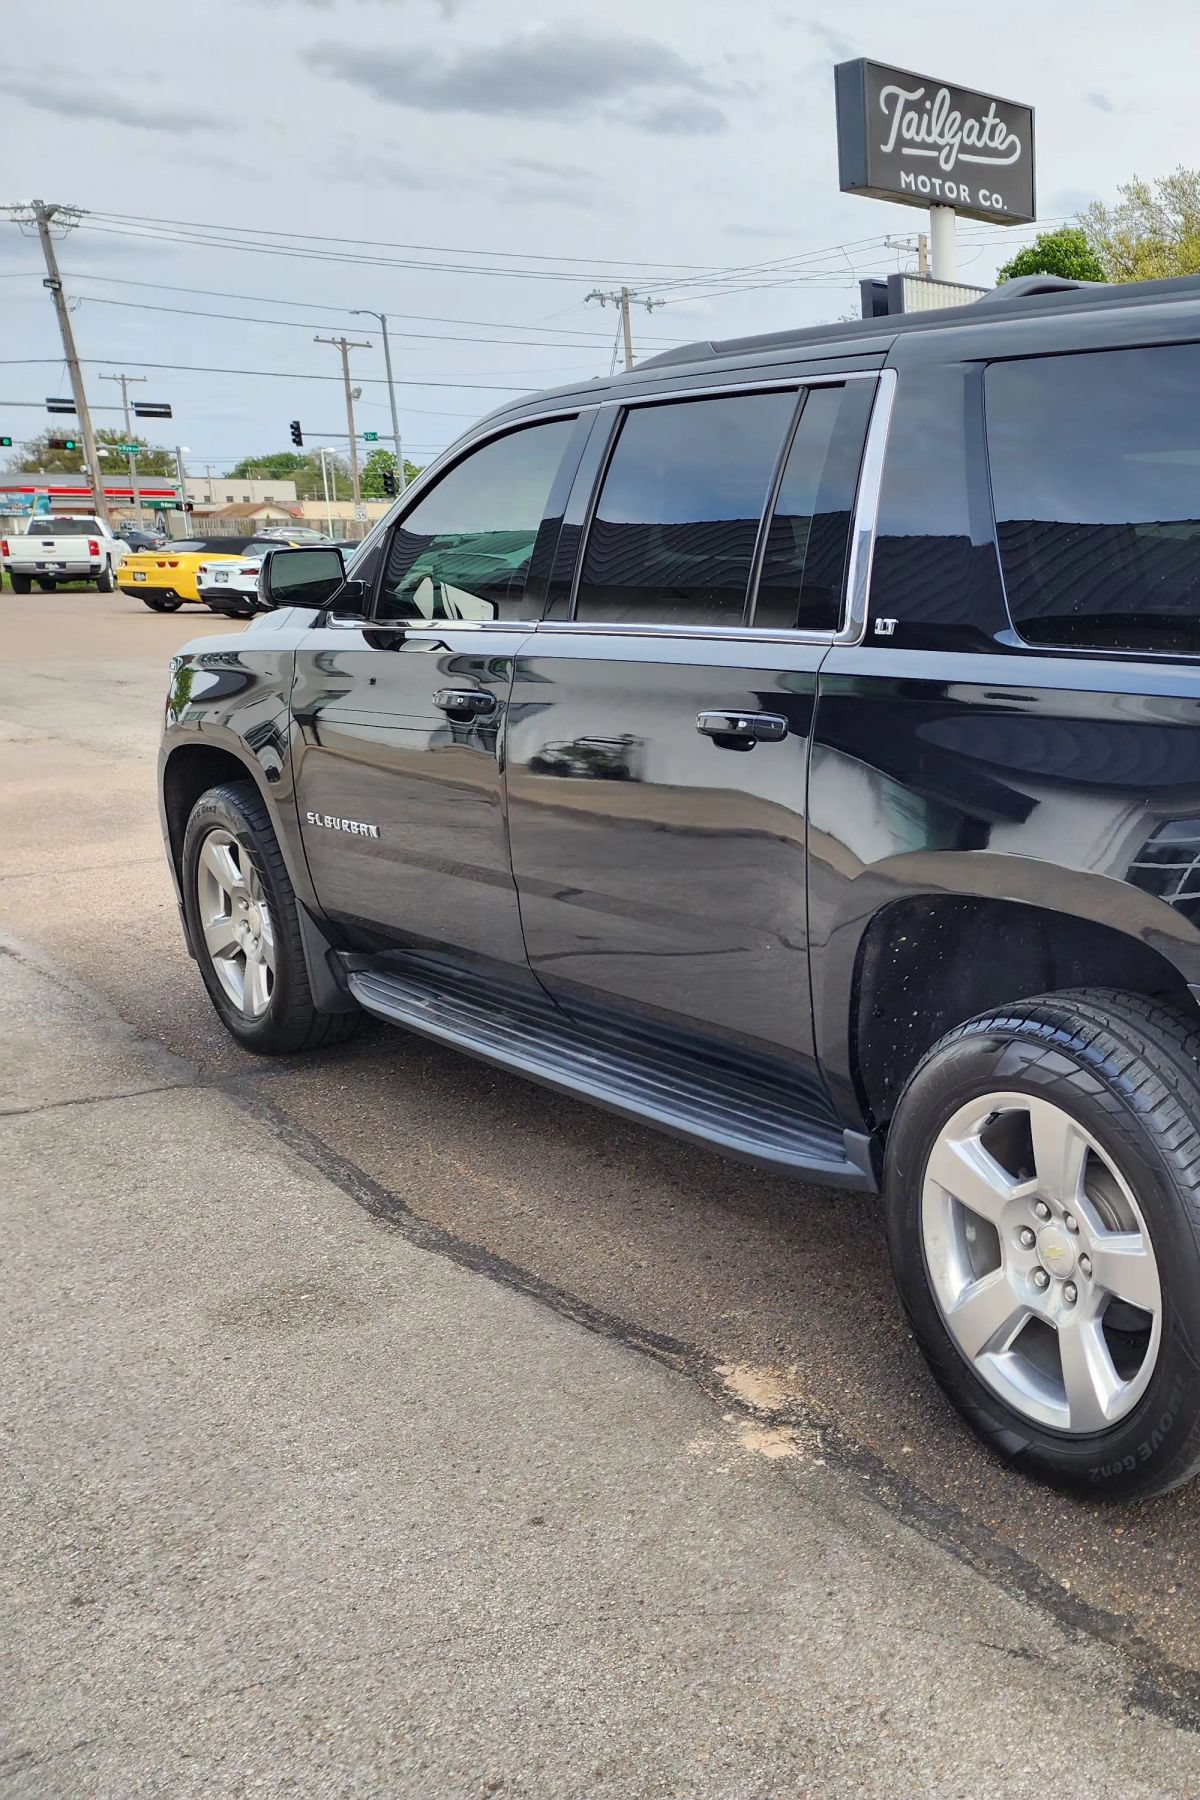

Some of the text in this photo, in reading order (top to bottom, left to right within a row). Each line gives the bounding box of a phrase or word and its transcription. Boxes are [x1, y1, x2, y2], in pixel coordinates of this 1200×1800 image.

[879, 85, 1021, 171] Tailgate
[900, 171, 1008, 210] MOTOR CO.
[874, 617, 898, 635] LT
[1088, 1454, 1137, 1483] Gen2
